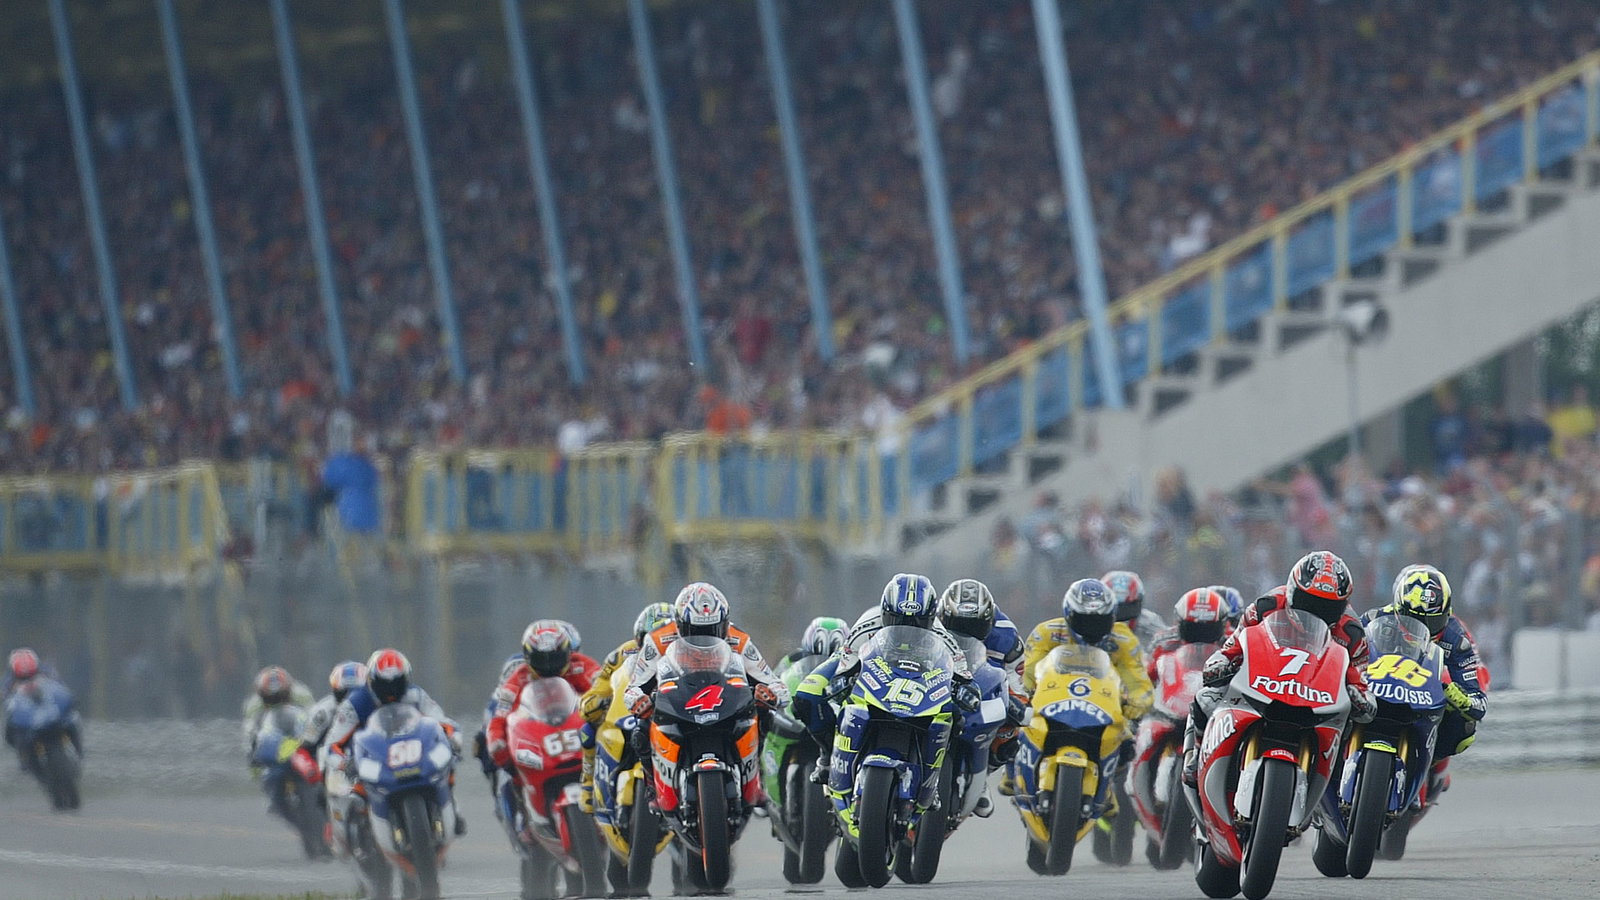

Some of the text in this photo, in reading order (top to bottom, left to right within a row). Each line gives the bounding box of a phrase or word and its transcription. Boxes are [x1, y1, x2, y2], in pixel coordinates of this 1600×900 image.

[899, 601, 920, 611] Arai
[1279, 647, 1310, 677] 7
[1366, 654, 1433, 688] 46
[684, 684, 724, 711] 4
[881, 678, 928, 706] 15
[1067, 676, 1092, 698] 6
[1251, 675, 1334, 704] Fortuna
[1366, 681, 1433, 705] AULOISES
[1043, 699, 1106, 724] CAMEL
[543, 729, 581, 756] 65
